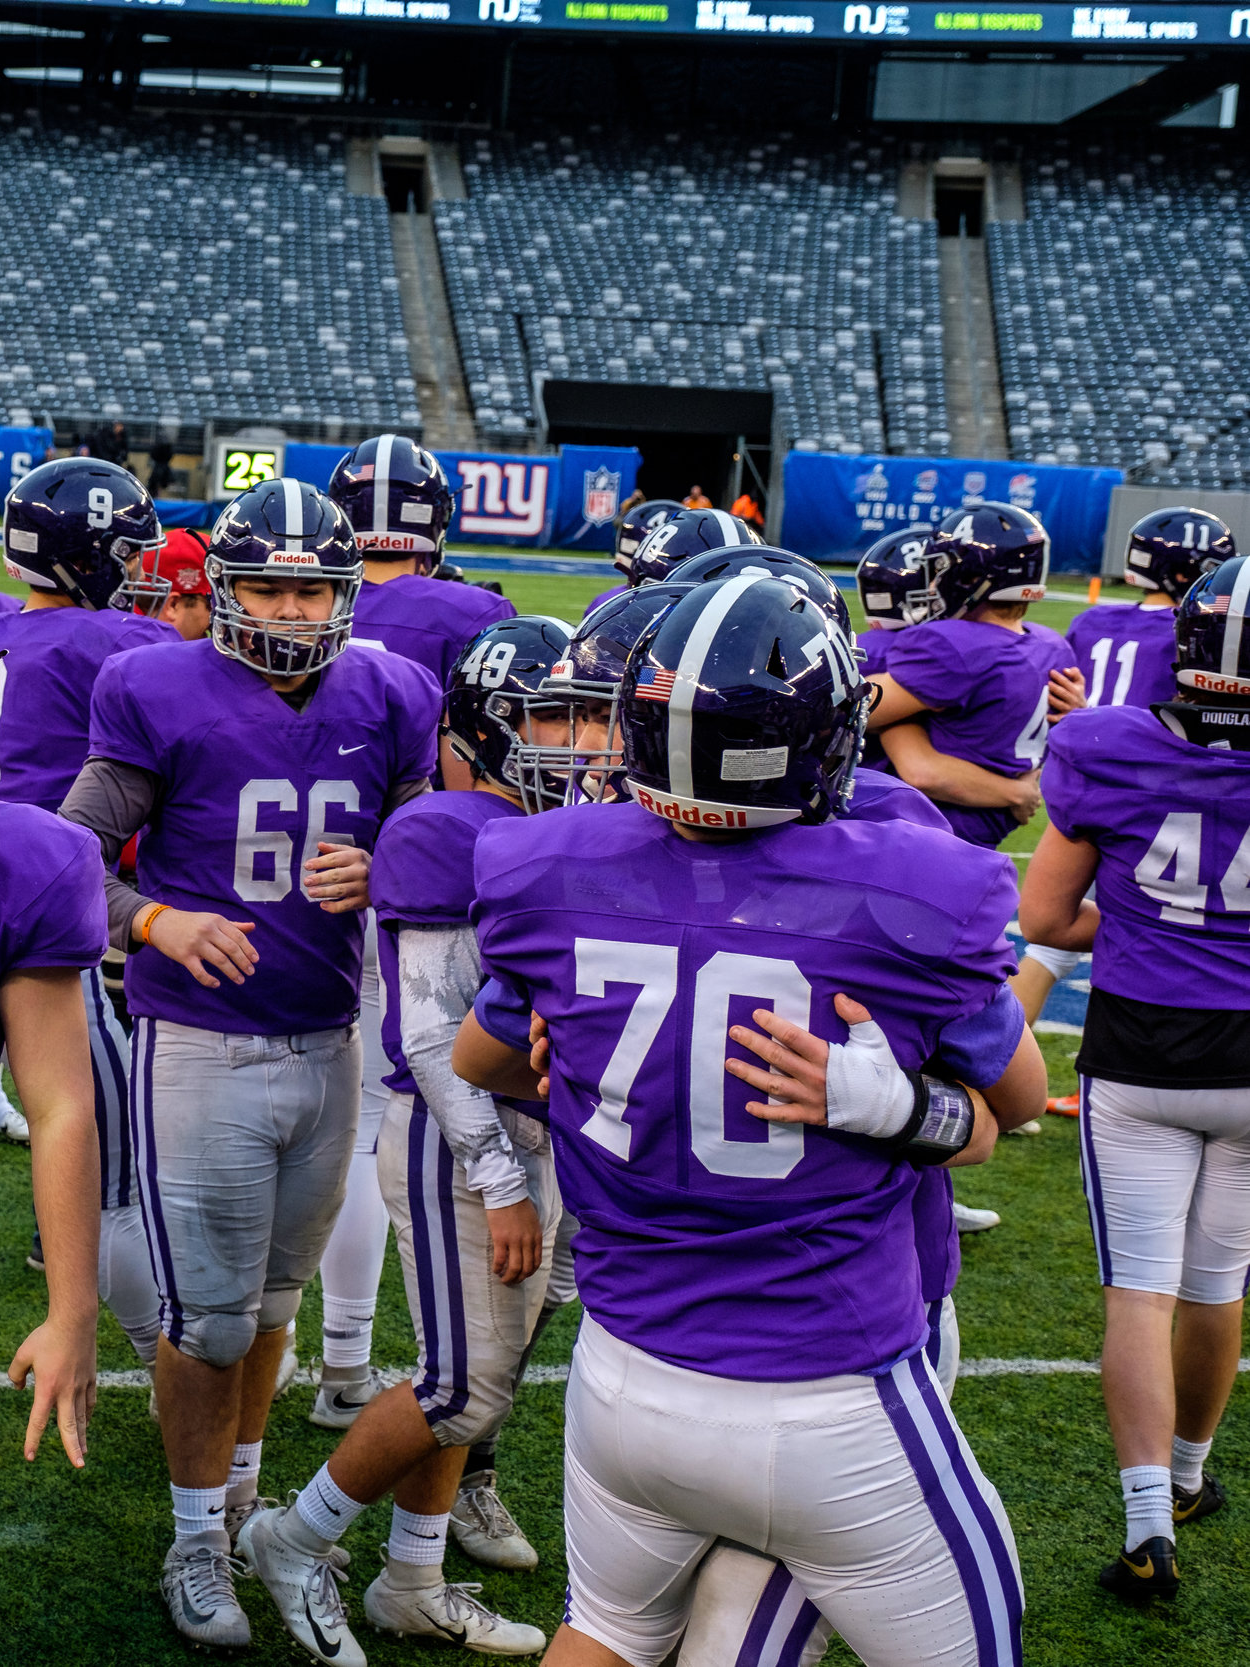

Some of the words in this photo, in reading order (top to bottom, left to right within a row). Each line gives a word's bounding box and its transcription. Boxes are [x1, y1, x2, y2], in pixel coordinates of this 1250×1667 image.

[224, 451, 276, 490] 25
[87, 487, 113, 529] 9
[855, 502, 921, 521] WORLD
[355, 536, 414, 550] Riddell
[952, 514, 975, 546] 4
[1181, 522, 1210, 551] 11
[274, 554, 315, 564] Riddell
[461, 641, 517, 688] 49
[1088, 637, 1139, 707] 11
[1194, 674, 1250, 695] Ridde
[1202, 711, 1250, 726] DOUGLA
[637, 788, 747, 828] Riddell
[233, 779, 361, 902] 66
[574, 937, 812, 1179] 70
